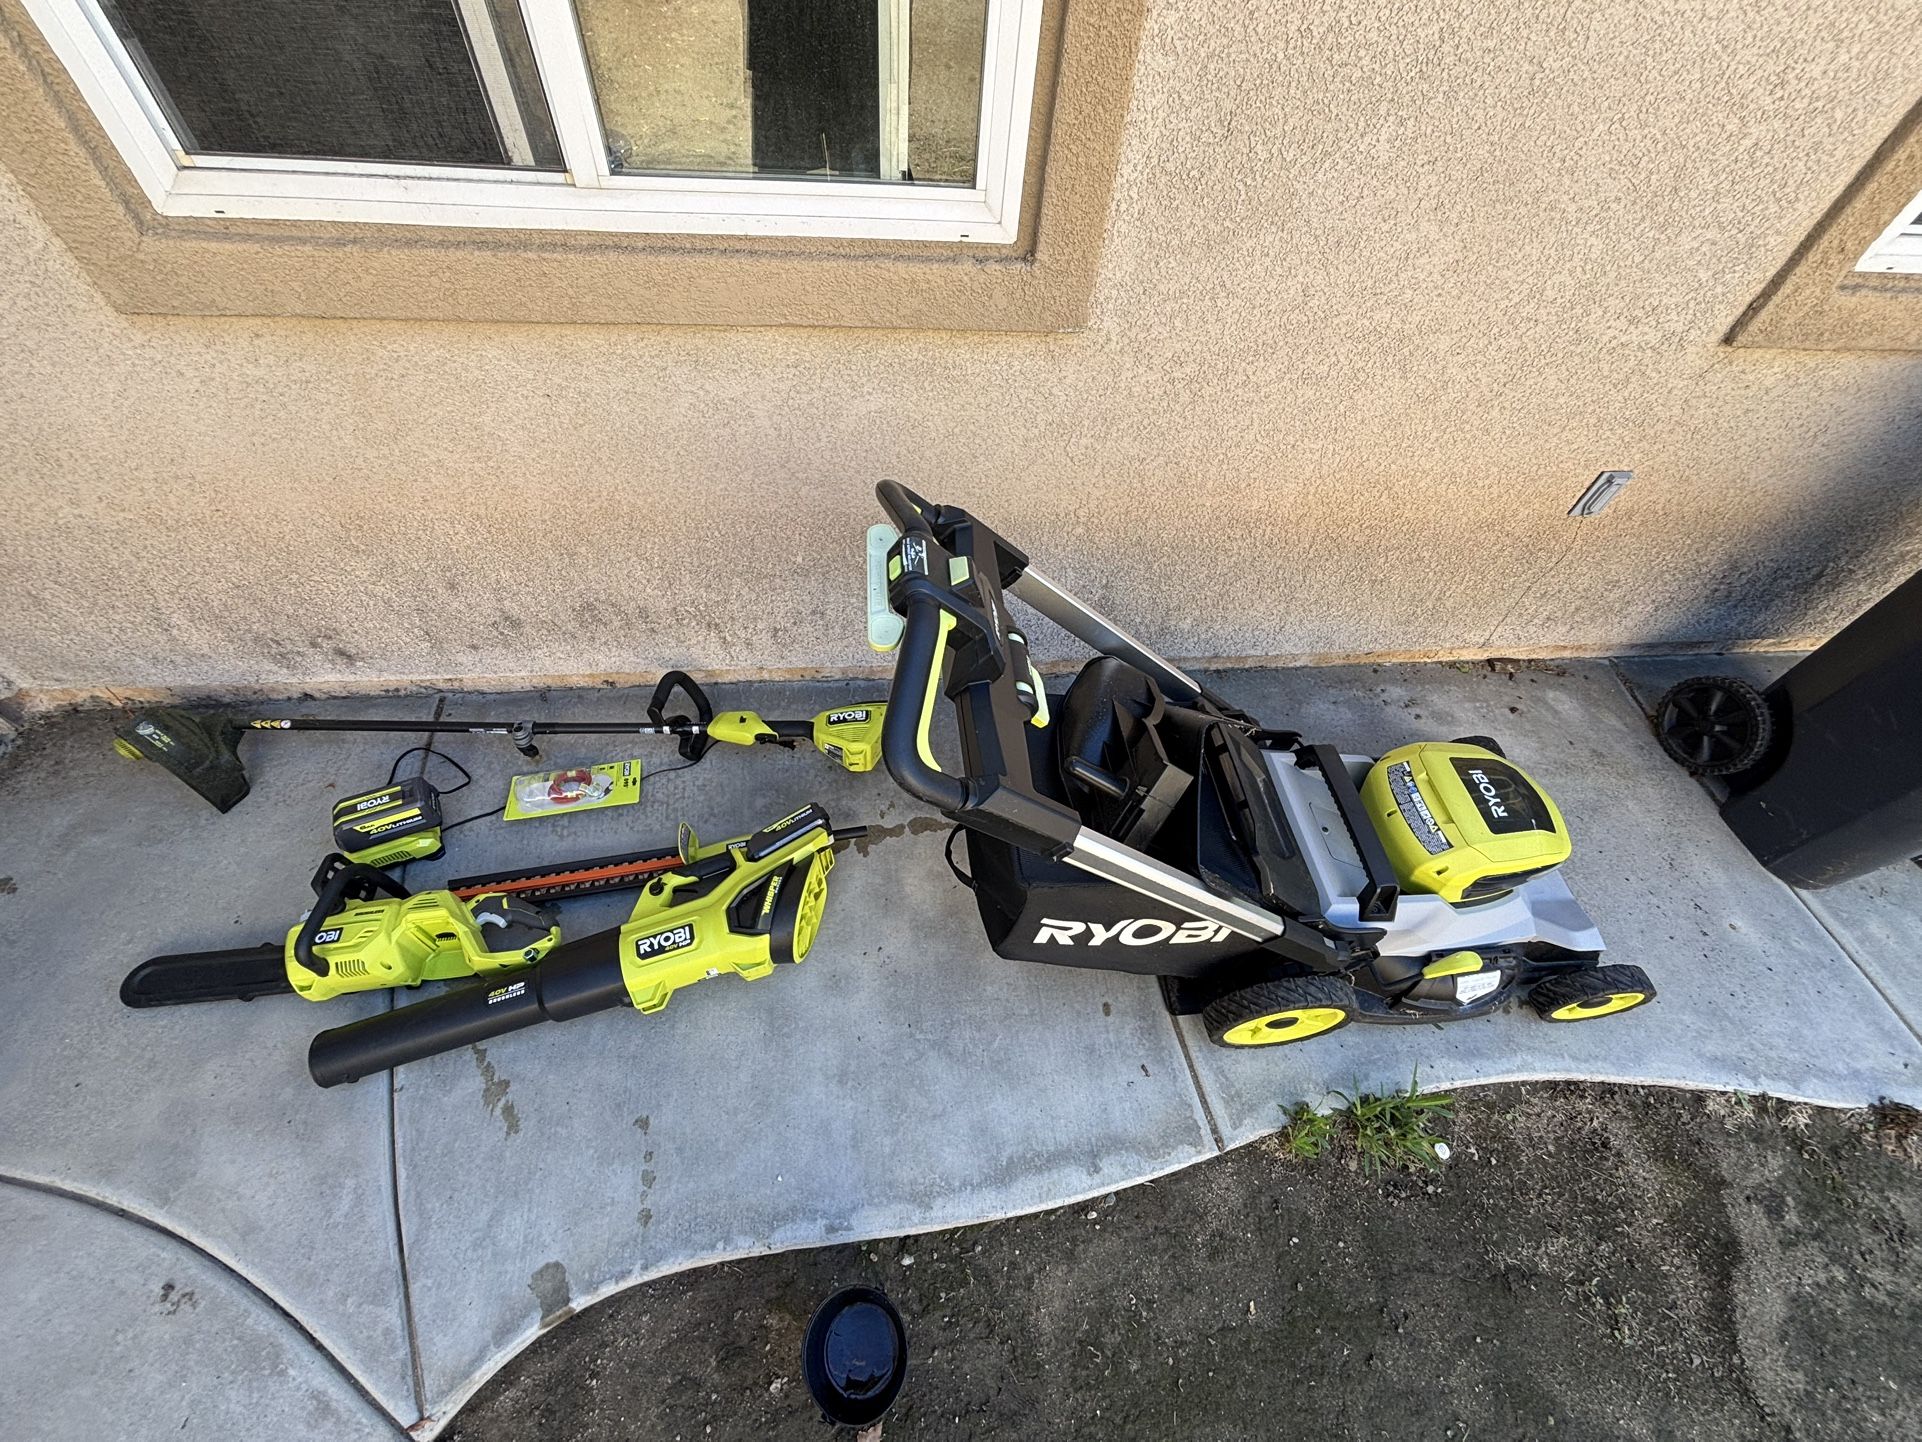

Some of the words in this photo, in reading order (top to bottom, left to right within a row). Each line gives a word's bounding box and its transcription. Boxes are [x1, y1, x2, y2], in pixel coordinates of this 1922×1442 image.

[830, 710, 866, 722] RYOBI
[1468, 769, 1509, 819] RYOBI
[357, 795, 390, 811] RYOBI
[762, 875, 780, 915] WHISPER
[314, 930, 340, 944] OBI
[637, 926, 691, 954] RYOBI
[488, 987, 508, 997] 40V
